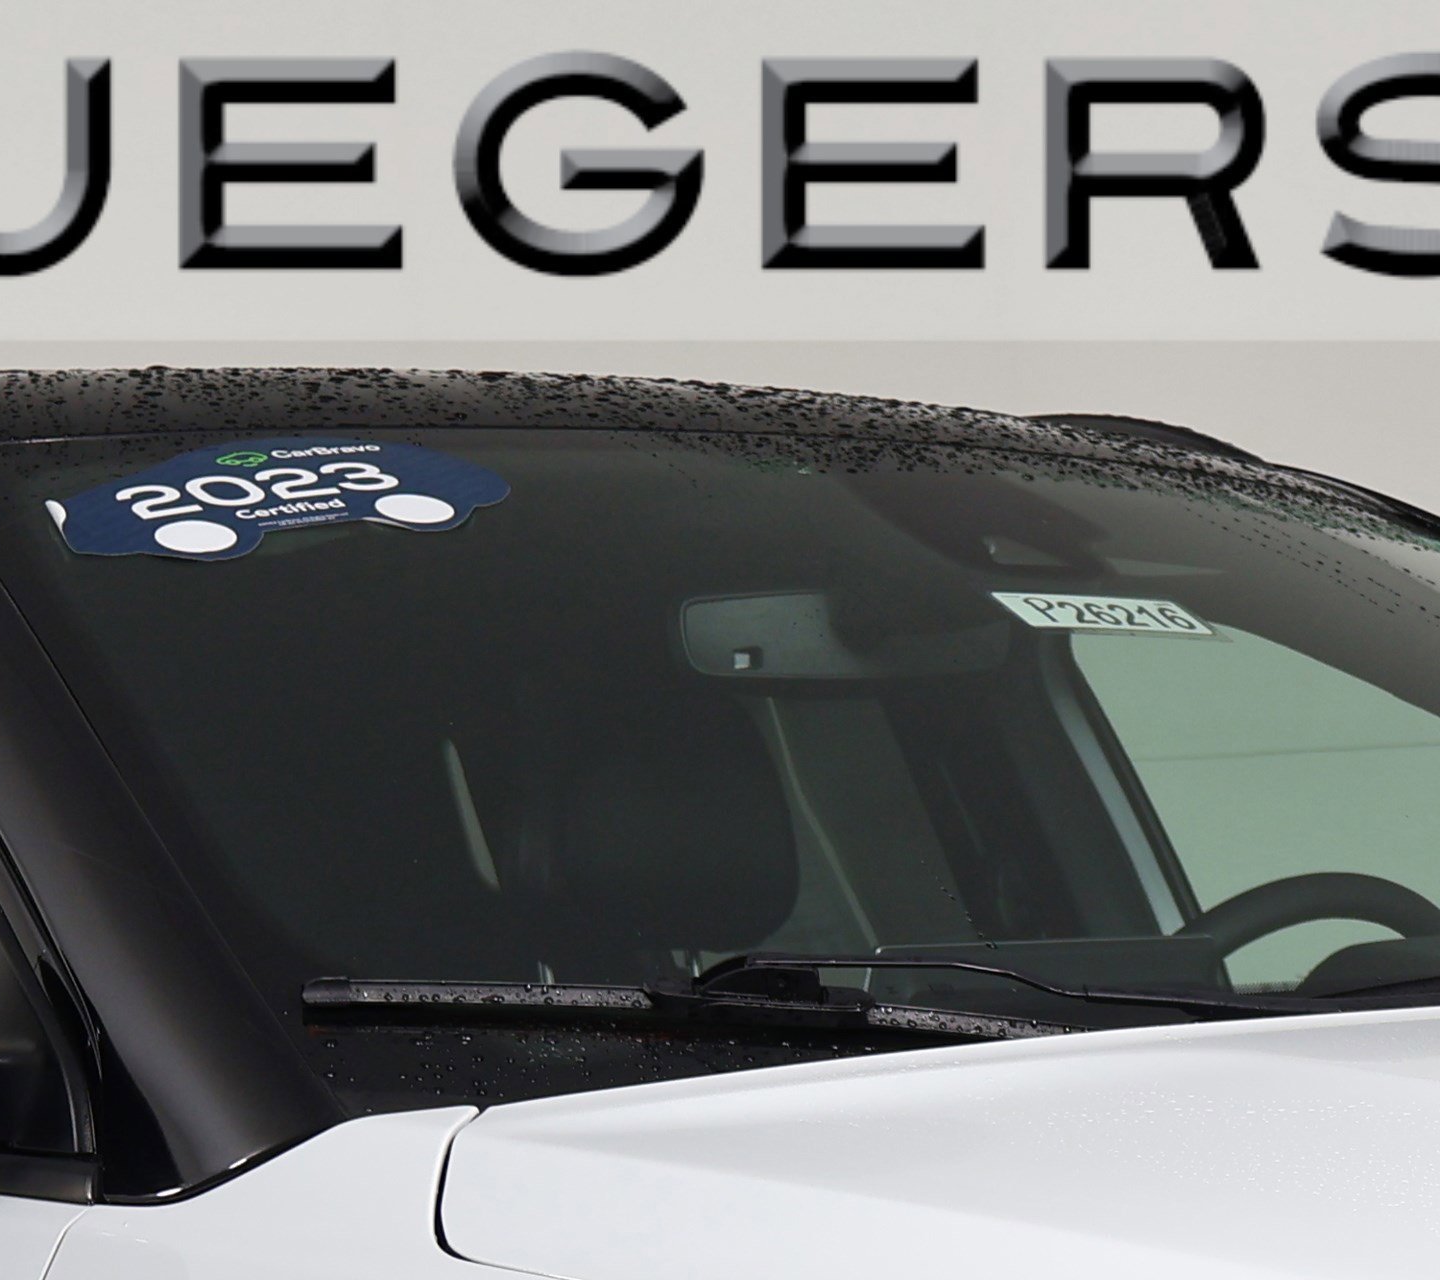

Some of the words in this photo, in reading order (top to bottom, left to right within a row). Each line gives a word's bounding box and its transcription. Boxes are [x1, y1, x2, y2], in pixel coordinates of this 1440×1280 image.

[270, 444, 381, 459] CarBravo
[116, 462, 399, 519] 2023
[234, 498, 346, 520] Certified
[1022, 596, 1197, 630] P26216
